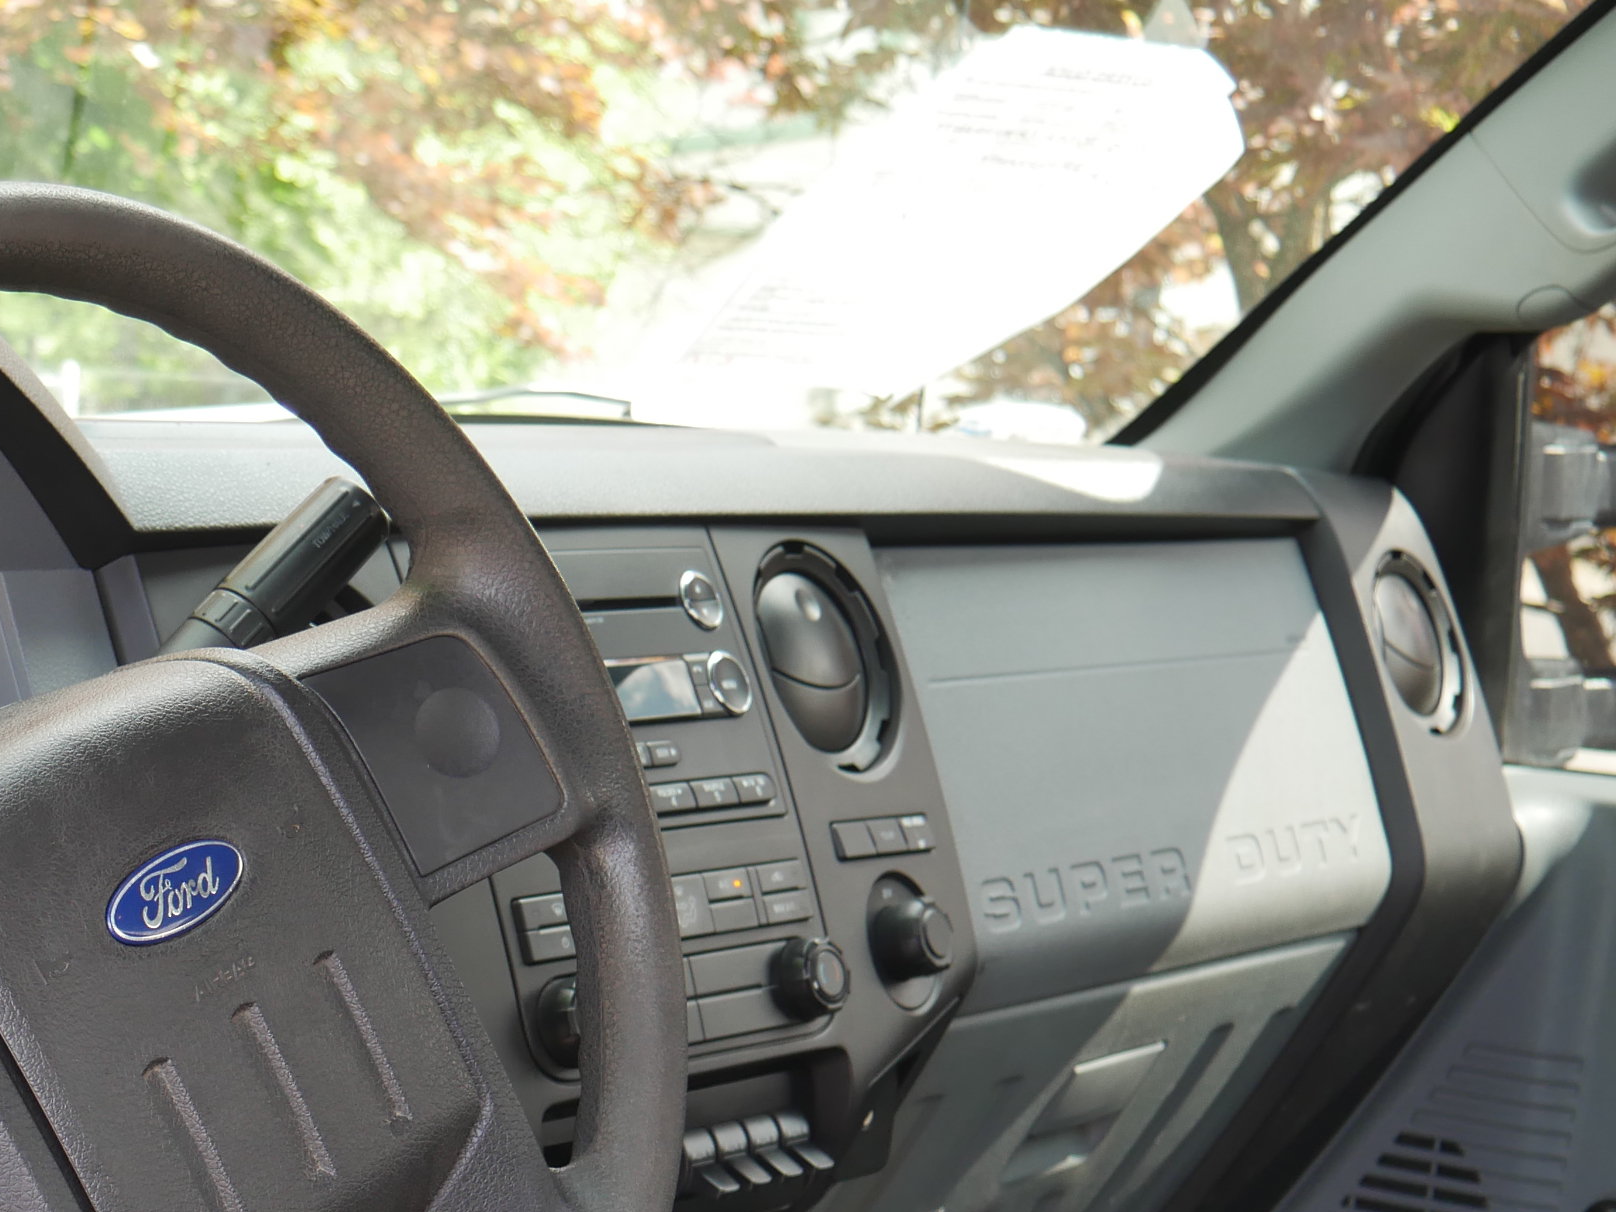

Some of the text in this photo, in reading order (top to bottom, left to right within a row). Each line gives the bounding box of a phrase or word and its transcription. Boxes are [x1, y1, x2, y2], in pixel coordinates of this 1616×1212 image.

[139, 856, 221, 929] Ford
[981, 812, 1362, 935] SUPER DUTY
